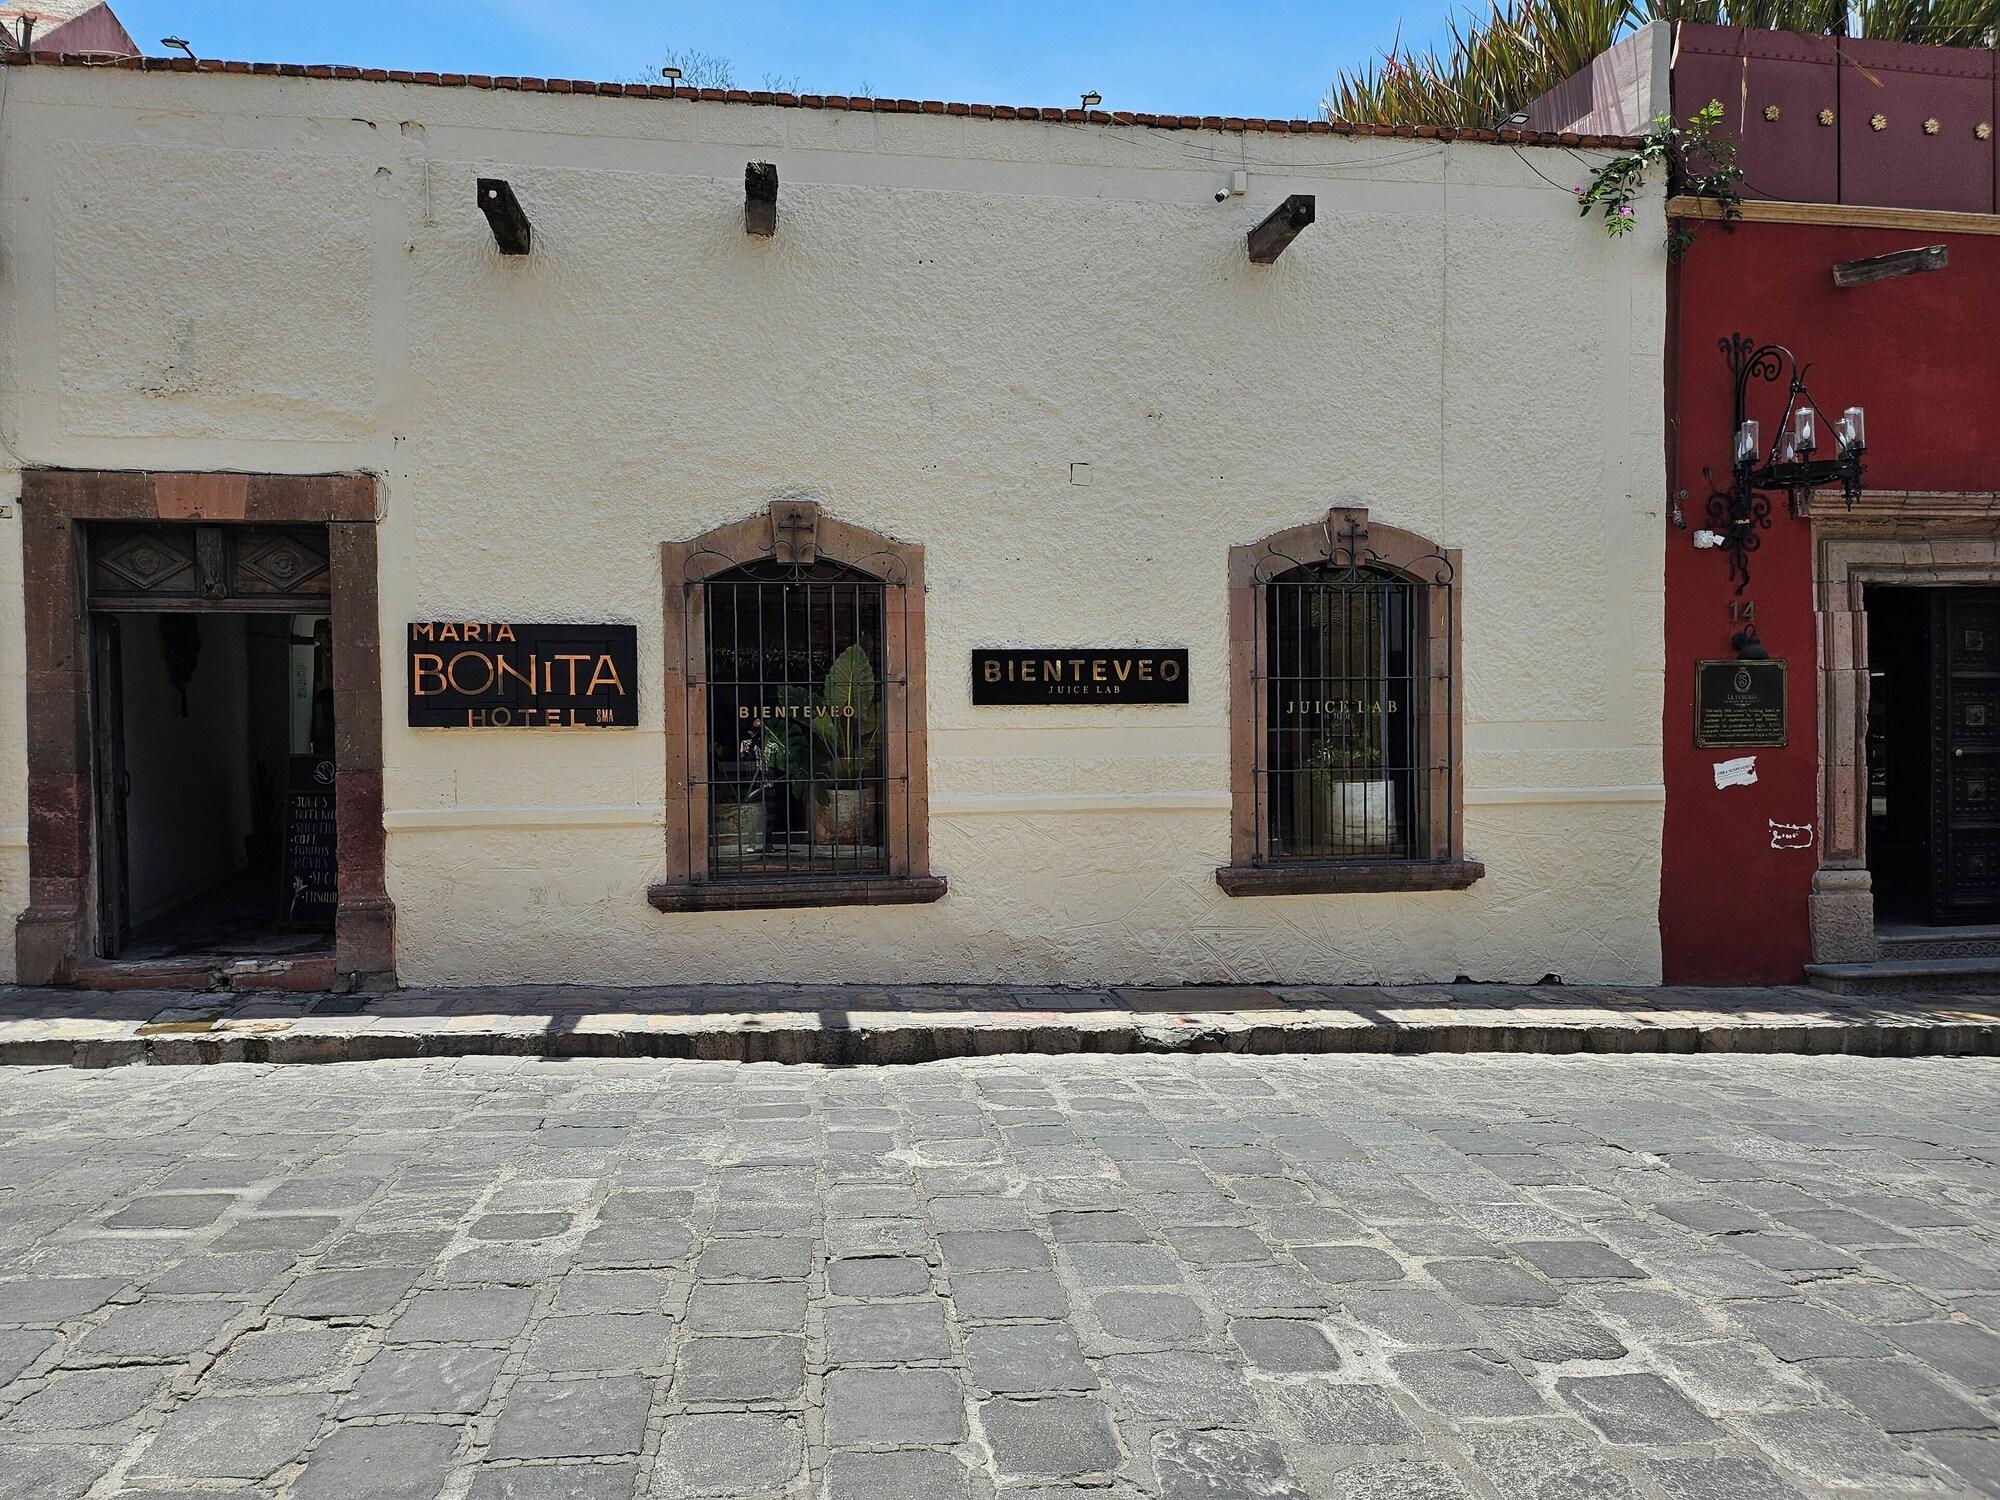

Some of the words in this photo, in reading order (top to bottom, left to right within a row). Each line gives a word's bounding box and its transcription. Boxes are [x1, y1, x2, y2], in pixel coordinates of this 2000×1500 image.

[1729, 601, 1755, 622] 14
[412, 620, 517, 642] MARIA
[984, 659, 1180, 682] BIENTEVEO
[1048, 686, 1089, 694] JUICE
[1096, 686, 1121, 694] LAB
[468, 706, 586, 728] HOTEL
[596, 708, 614, 723] SMA
[739, 705, 855, 718] BIENTEVEO
[1286, 700, 1350, 714] JUICE
[1357, 700, 1398, 714] LAB
